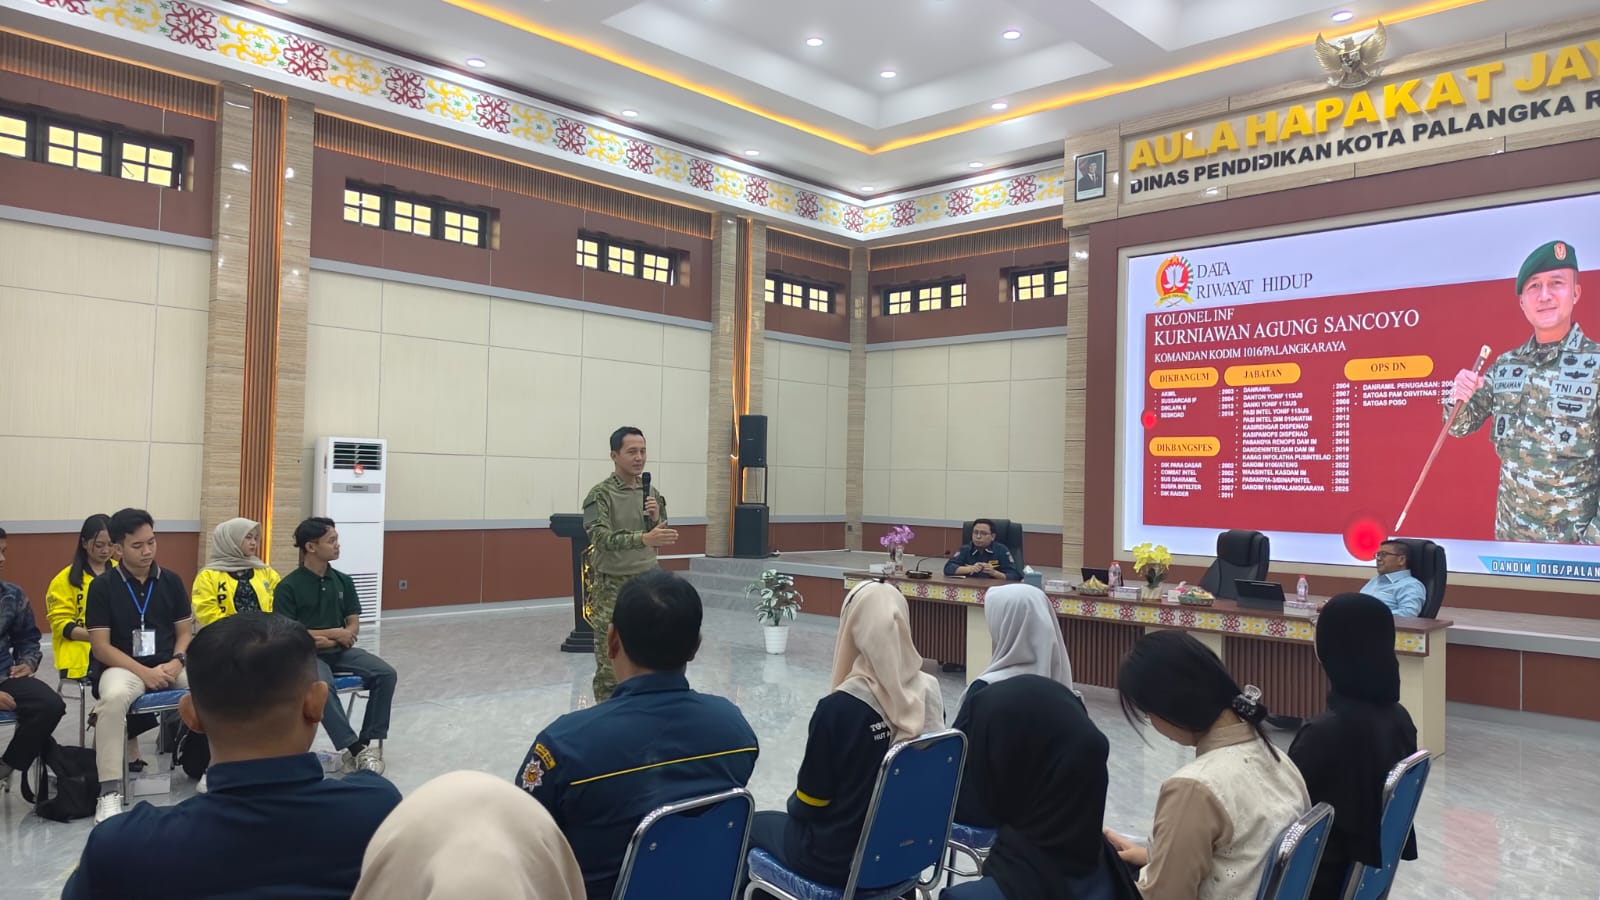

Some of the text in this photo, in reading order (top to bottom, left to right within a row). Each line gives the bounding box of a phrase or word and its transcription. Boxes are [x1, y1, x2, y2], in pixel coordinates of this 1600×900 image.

[1128, 121, 1240, 172] AULA
[1245, 61, 1504, 148] HAPAKAT
[1130, 172, 1189, 195] DINAS
[1193, 142, 1332, 184] PENDIDIKAN
[1336, 129, 1405, 157] KOTA
[1412, 95, 1576, 143] PALANGKA
[1197, 261, 1231, 279] DATA
[1196, 279, 1254, 300] RIWAYAT
[1262, 272, 1312, 293] HIDUP
[1154, 308, 1235, 327] KOLONEL INF
[1153, 309, 1420, 346] KURNIAWAN AGUNG SANCOYO
[1154, 341, 1346, 364] KOMANDAN KODIM 1016/PALANGKARAYA
[1243, 369, 1282, 380] JABATAN
[1371, 361, 1407, 374] OPS DN
[1159, 372, 1209, 383] DIKBANGUM
[1555, 383, 1592, 396] TNI AD
[1157, 443, 1212, 453] DIKBANGSPES
[1492, 560, 1531, 573] DANDIM
